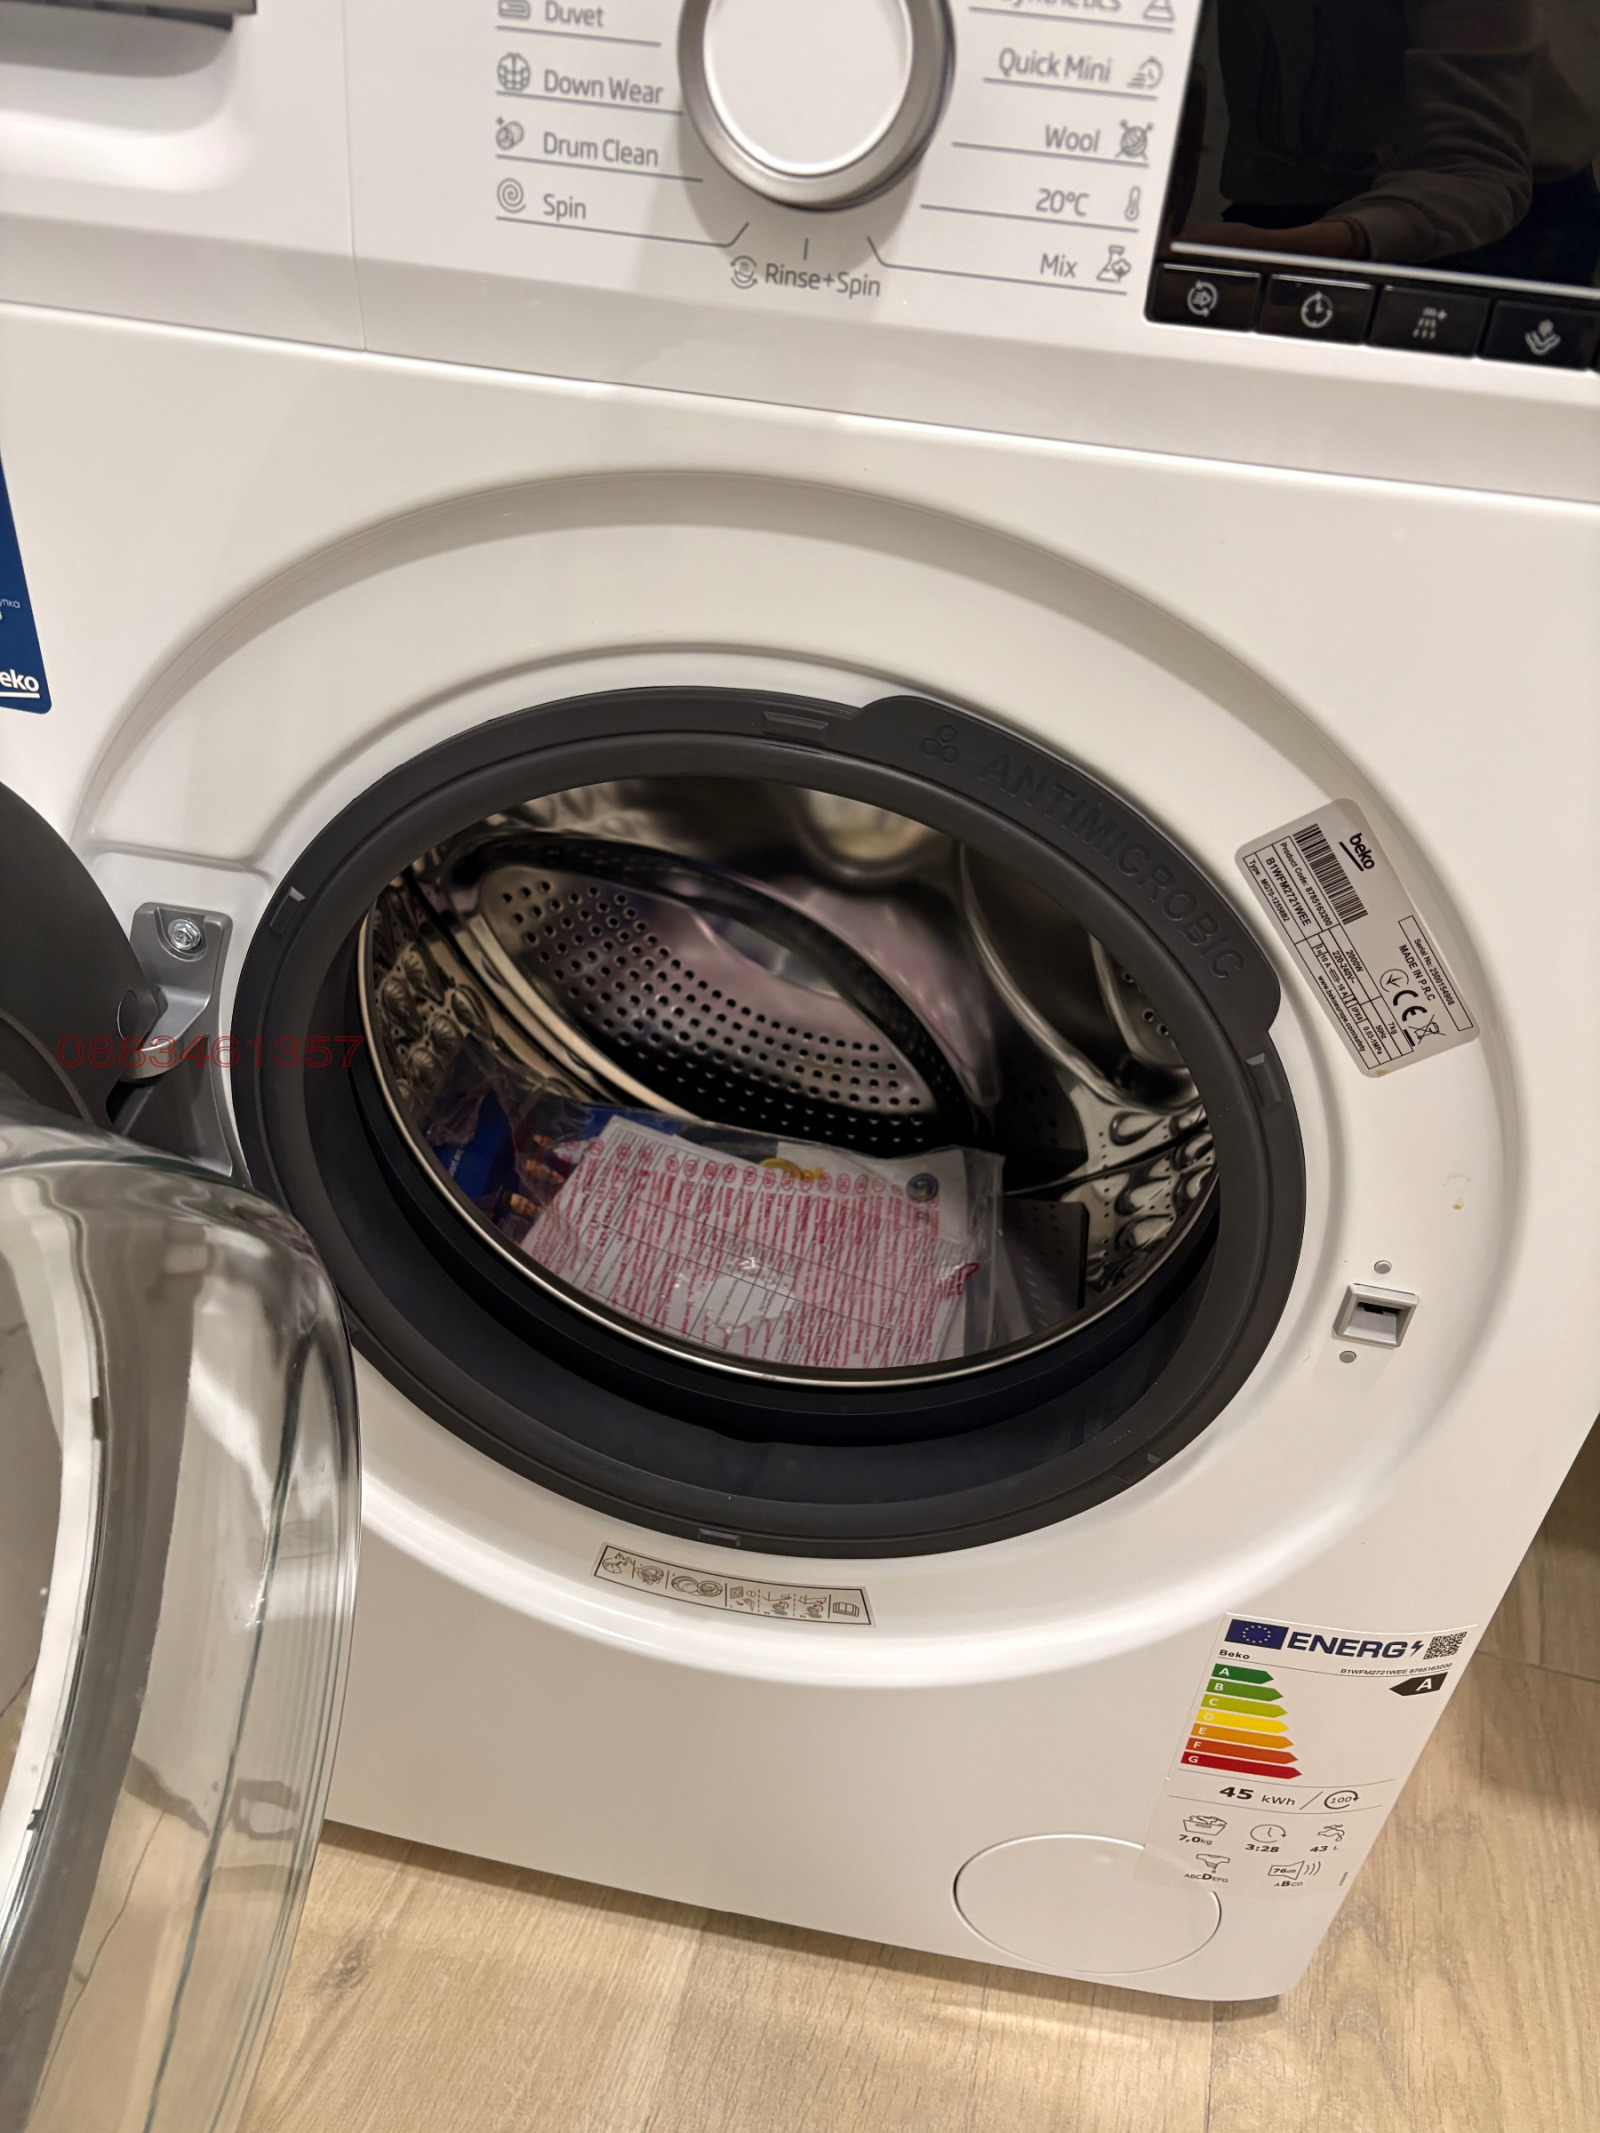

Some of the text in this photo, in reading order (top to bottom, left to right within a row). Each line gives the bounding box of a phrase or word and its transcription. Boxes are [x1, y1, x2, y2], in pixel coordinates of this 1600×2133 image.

[545, 0, 604, 28] Duvet
[999, 48, 1113, 82] Quick Mini
[544, 69, 664, 104] Down Wear
[543, 131, 659, 167] Drum Clean
[1044, 124, 1101, 153] Wool
[543, 193, 587, 222] Spin
[1040, 252, 1079, 279] Mix
[765, 263, 881, 299] Rinse+Spin
[1349, 832, 1375, 870] beko
[975, 753, 1244, 980] ANTIMICROBIC
[1265, 856, 1312, 927] B1WFM2721WEE
[1280, 842, 1333, 927] Product Code: 8785163200
[1413, 938, 1429, 957] Serial
[1398, 943, 1436, 1002] MADE IN P.R.C
[1218, 1649, 1250, 1660] Beko
[1218, 1667, 1230, 1676] A
[1415, 1677, 1433, 1692] A
[1213, 1683, 1224, 1691] B
[1208, 1698, 1219, 1706] C
[1203, 1713, 1214, 1721] D
[1198, 1727, 1208, 1735] E
[1193, 1741, 1202, 1749] F
[1188, 1755, 1199, 1763] G
[1219, 1786, 1352, 1806] 45 kWh 100
[1245, 1843, 1280, 1853] 3:28
